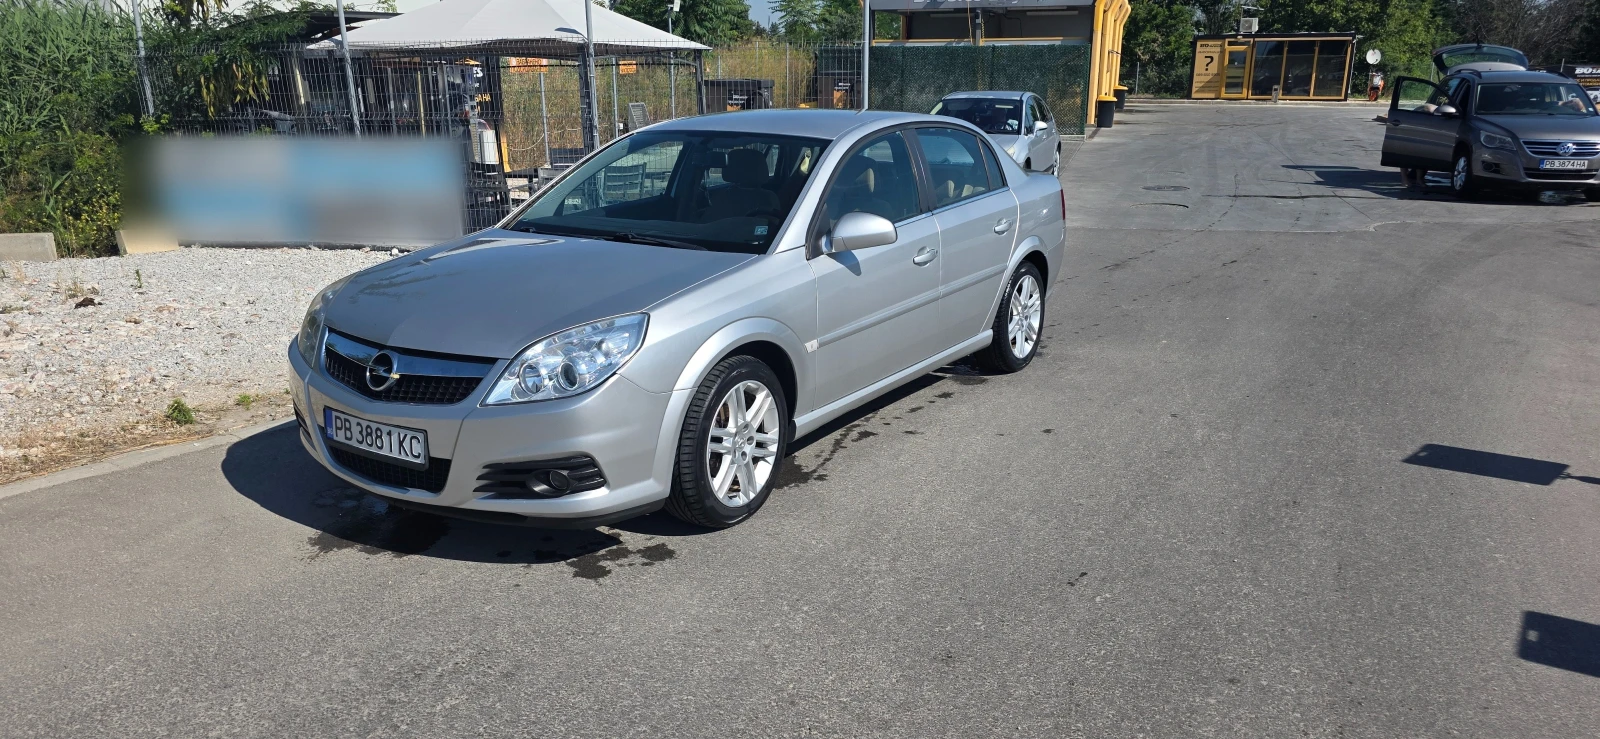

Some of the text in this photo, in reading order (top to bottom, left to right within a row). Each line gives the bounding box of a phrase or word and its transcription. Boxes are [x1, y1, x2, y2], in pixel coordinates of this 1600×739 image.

[334, 415, 421, 459] PB 3881 KC
